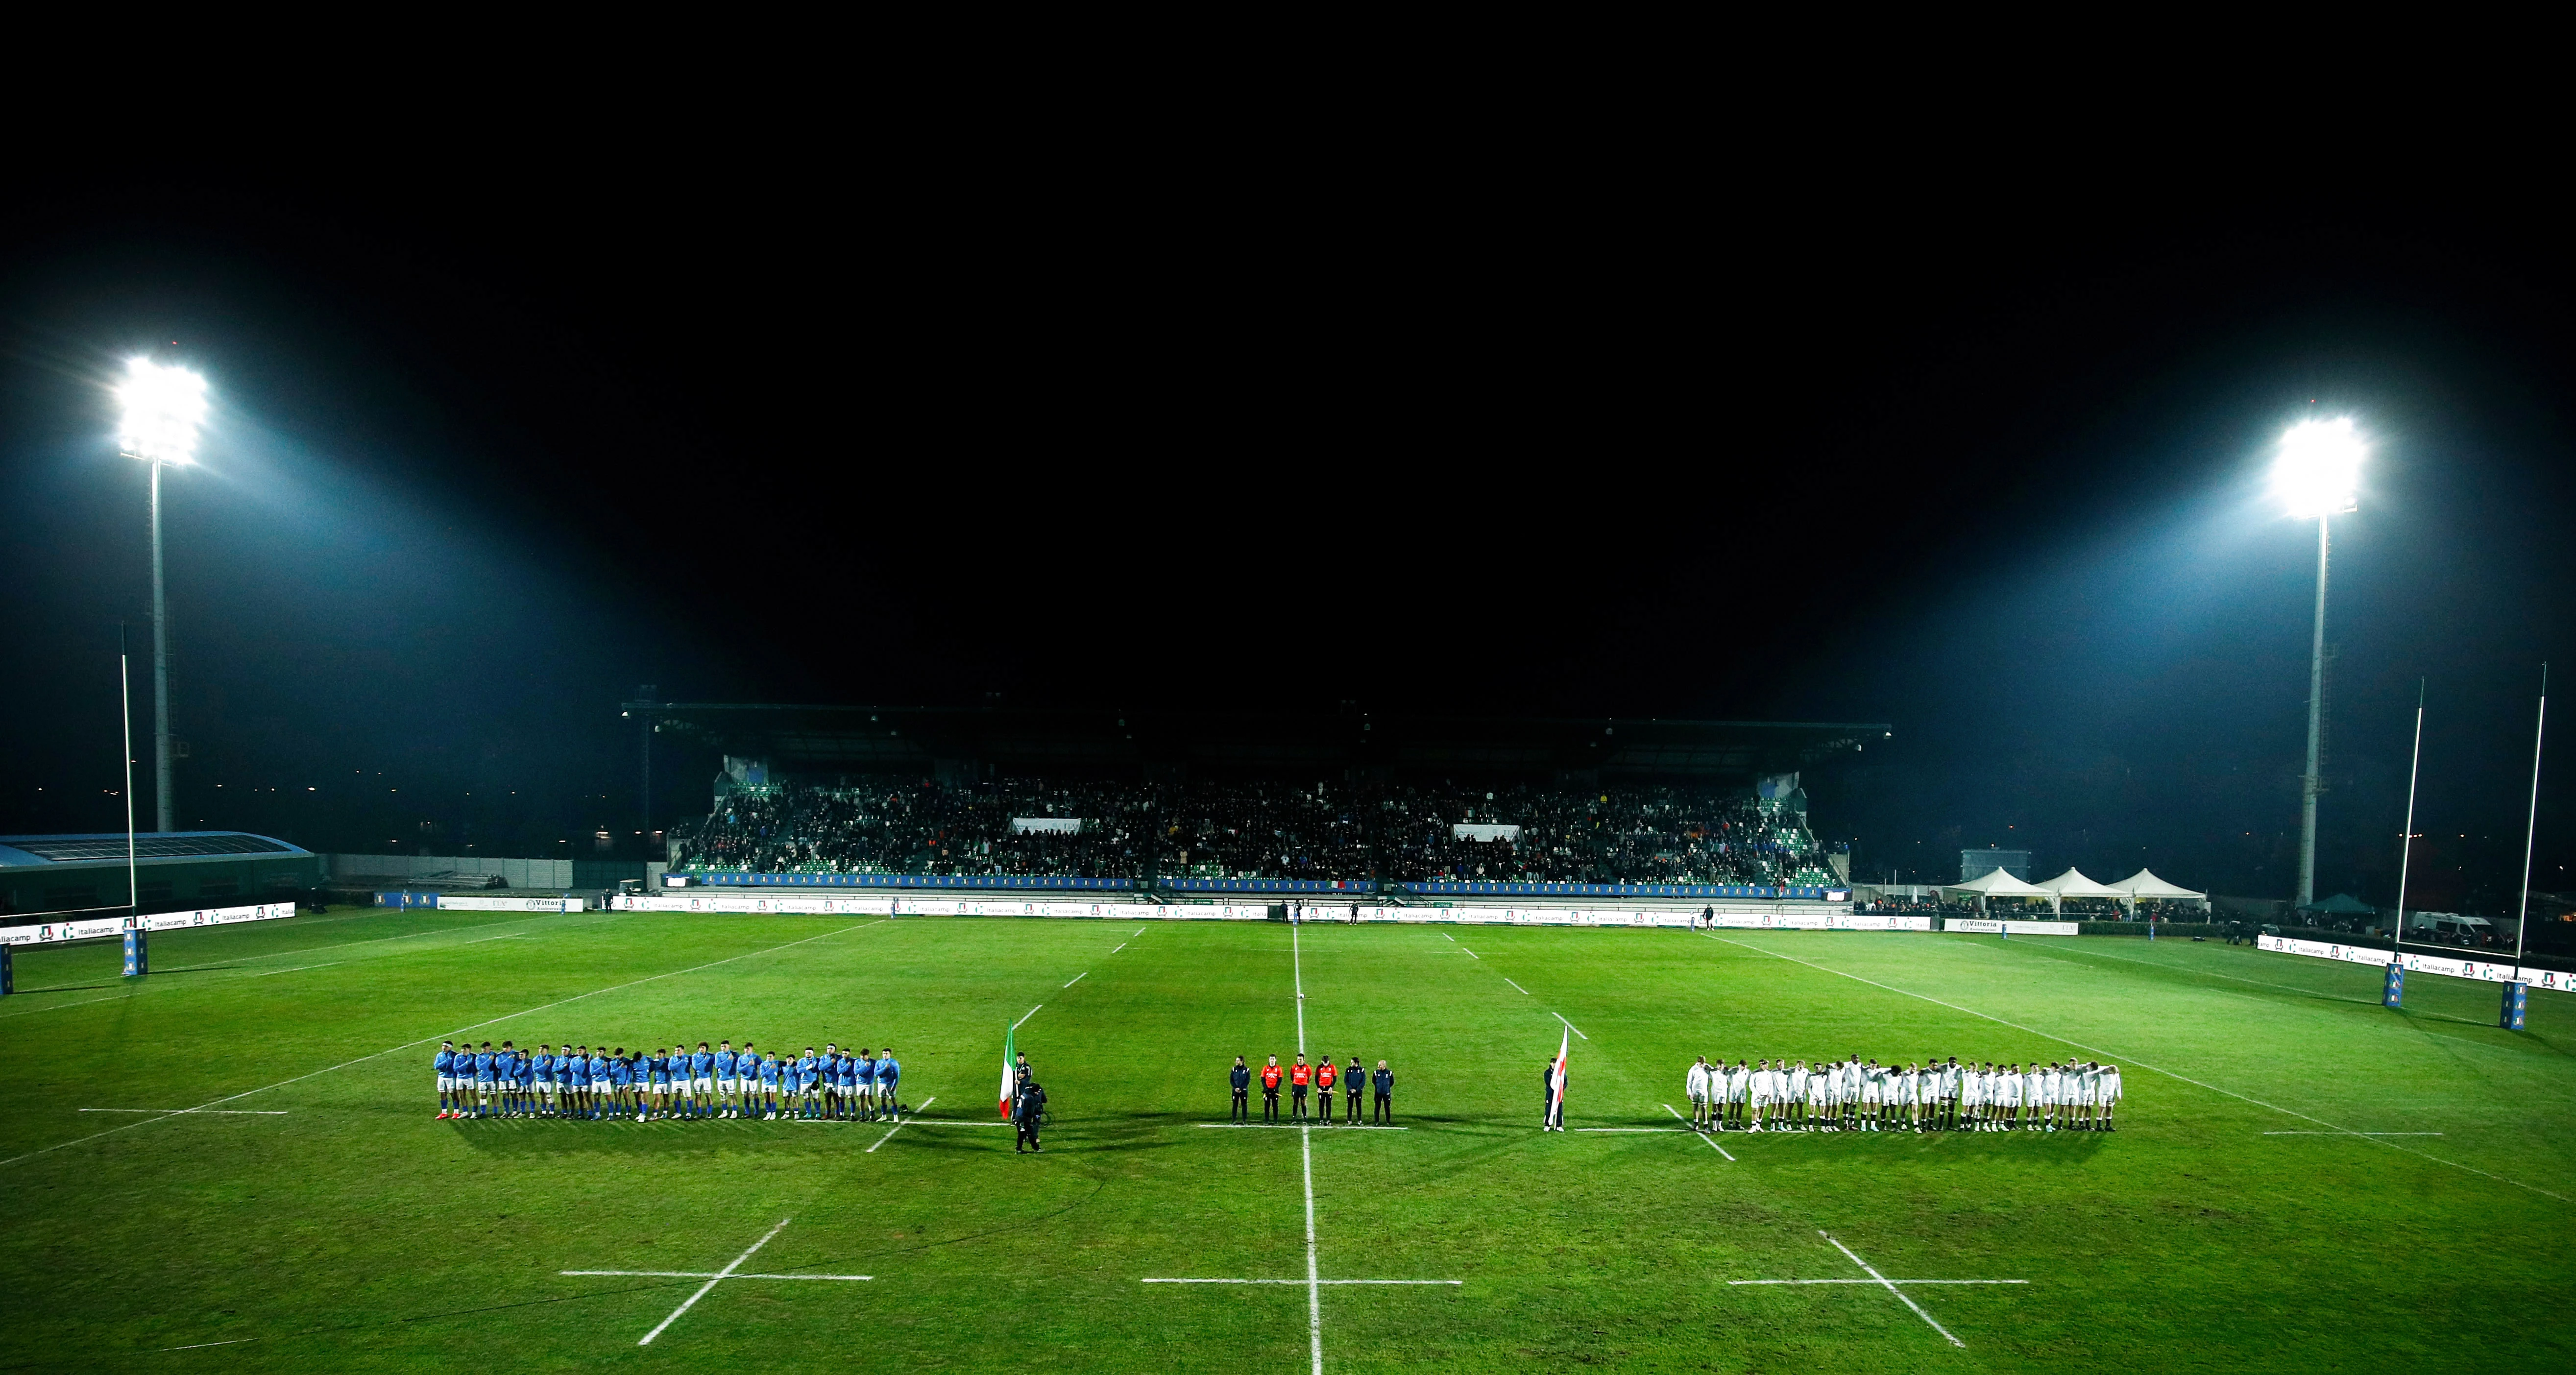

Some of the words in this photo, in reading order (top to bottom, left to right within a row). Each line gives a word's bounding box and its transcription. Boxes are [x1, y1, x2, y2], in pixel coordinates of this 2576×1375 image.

[78, 927, 114, 935] Italiacamp
[2357, 955, 2385, 964] Italiacamp
[2423, 964, 2454, 973] Italiacamp
[2497, 972, 2532, 984] Italiaamp
